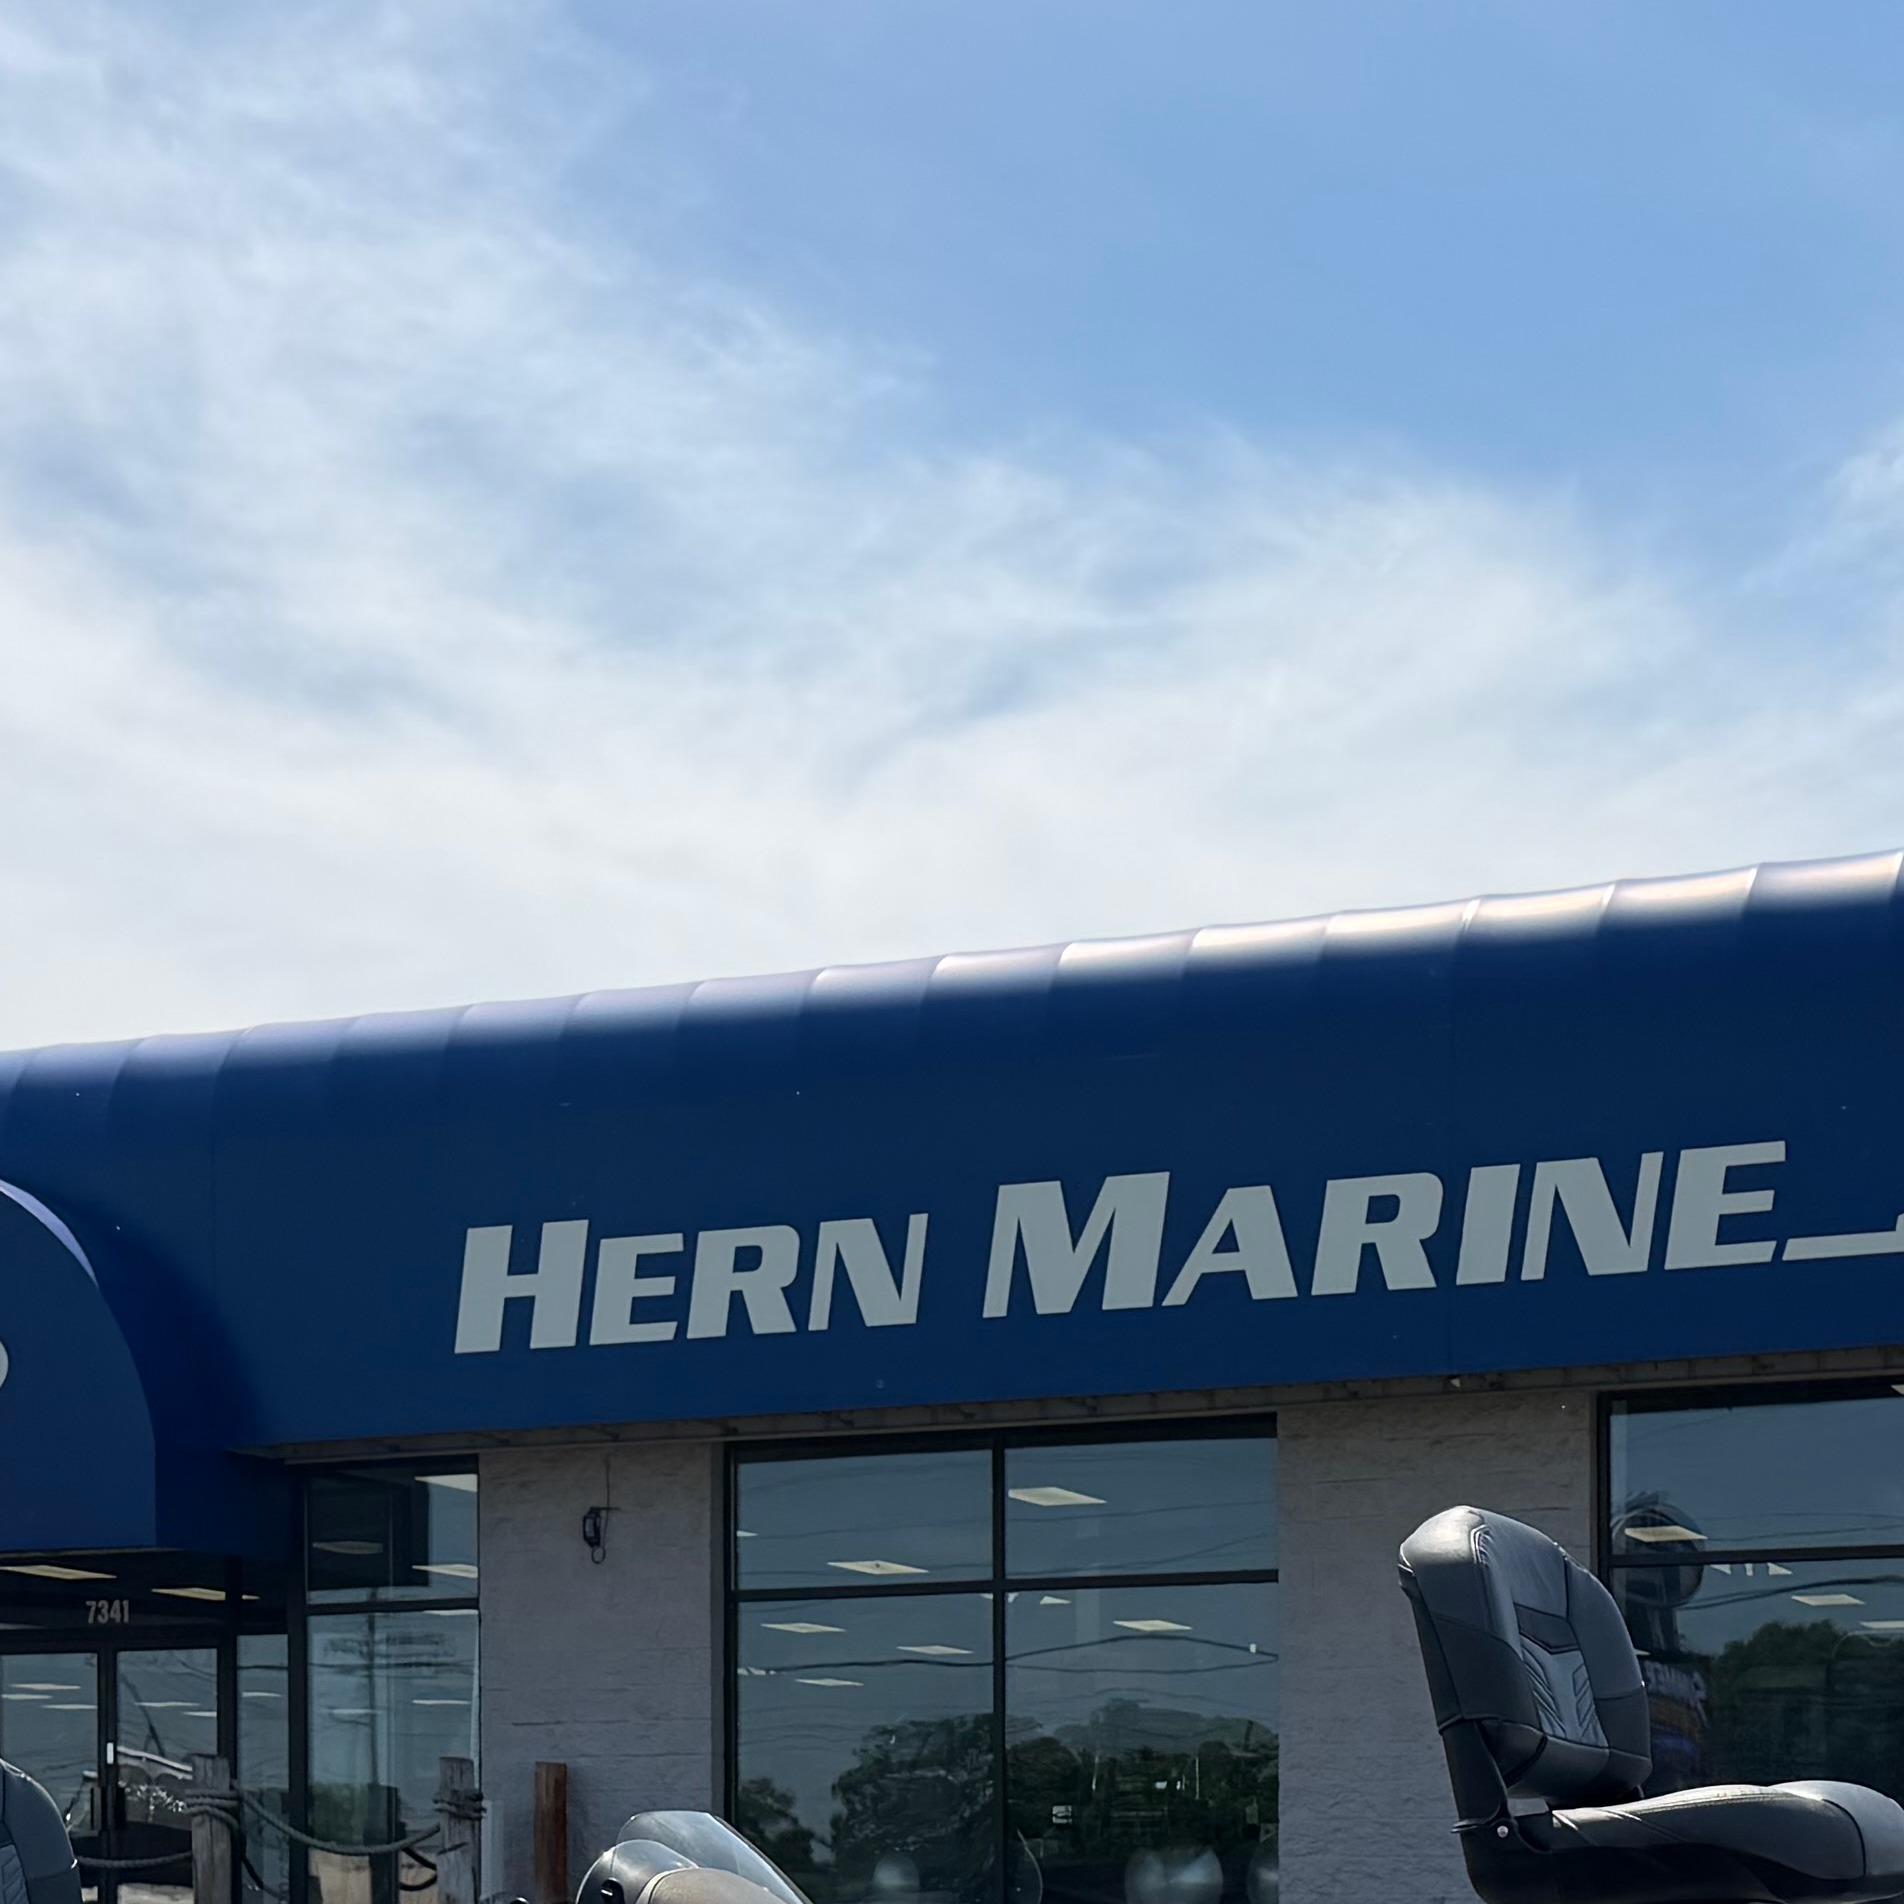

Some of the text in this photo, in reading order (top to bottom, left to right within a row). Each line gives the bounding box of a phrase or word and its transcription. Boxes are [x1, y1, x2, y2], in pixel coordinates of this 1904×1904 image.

[454, 1140, 1786, 1354] HERN MARINE
[85, 1599, 129, 1624] 7341
